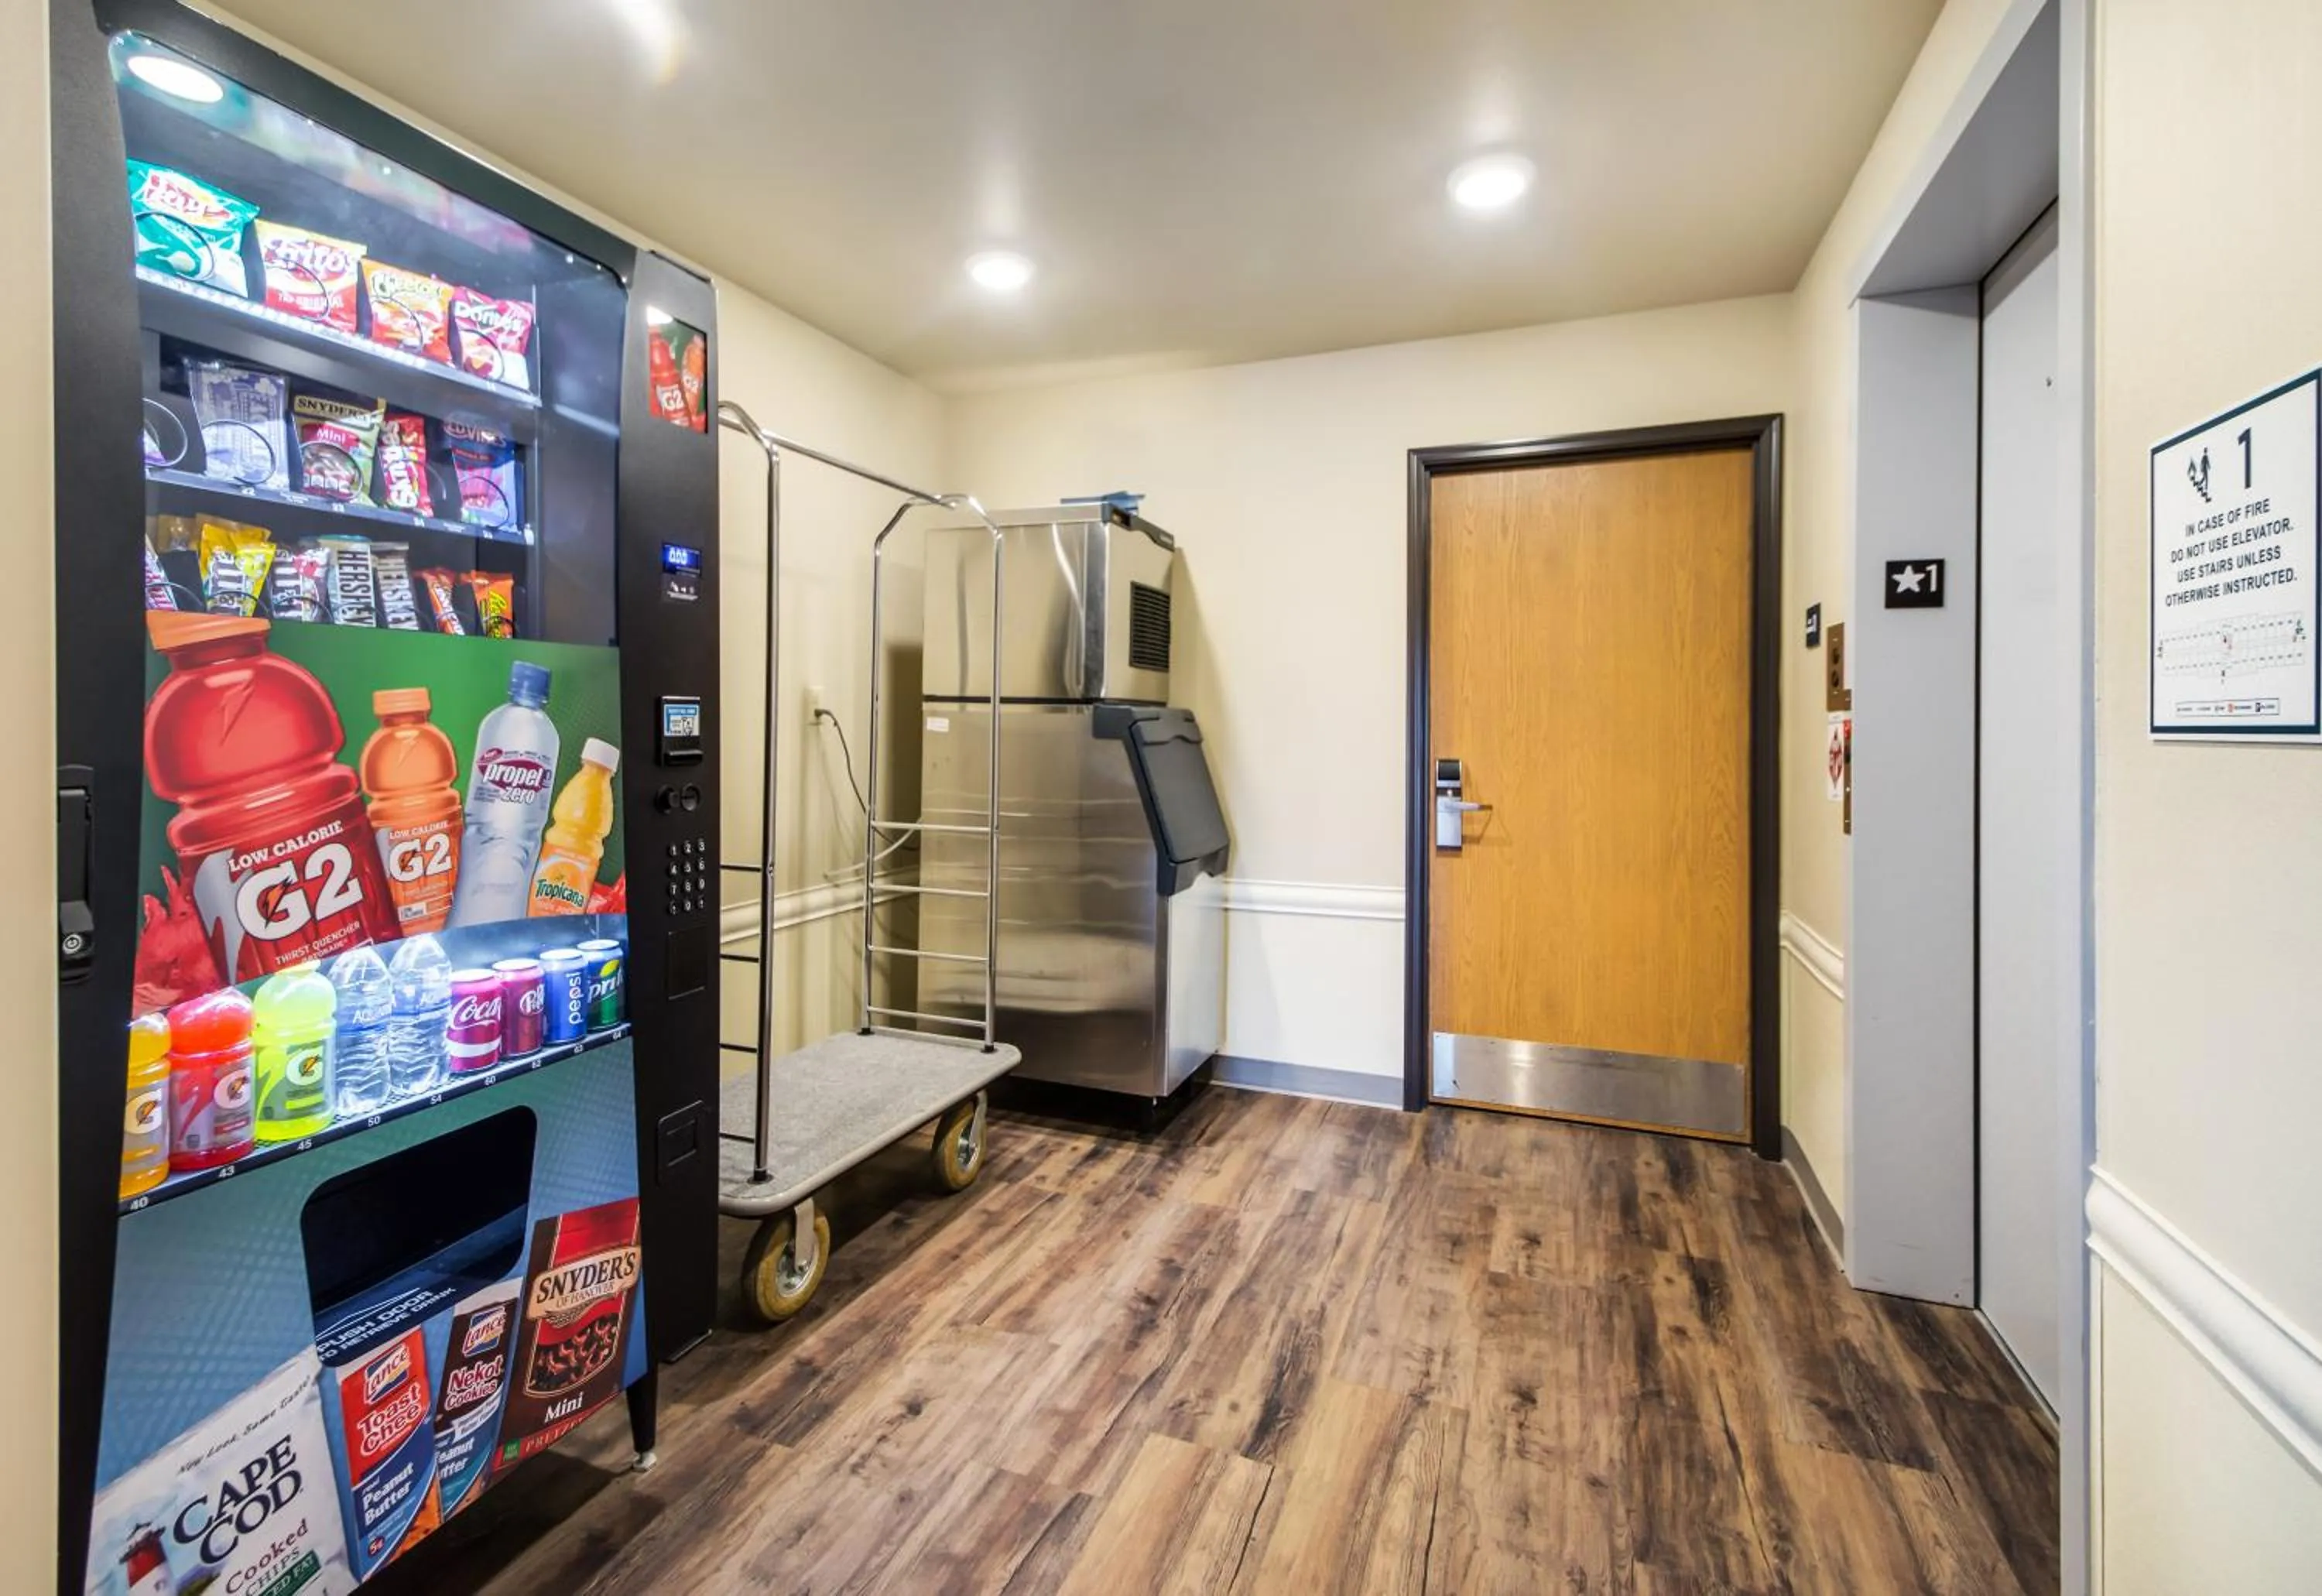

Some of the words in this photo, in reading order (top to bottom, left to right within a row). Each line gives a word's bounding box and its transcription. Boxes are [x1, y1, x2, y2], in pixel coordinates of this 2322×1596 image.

[2236, 426, 2253, 489] 1
[2185, 523, 2195, 537] IN
[2198, 513, 2224, 533] CASE
[2227, 508, 2242, 524] OF
[2245, 498, 2270, 519] FIRE
[2171, 549, 2183, 563] DO
[2187, 543, 2205, 559] NOT
[2208, 535, 2228, 553] USE
[2231, 518, 2293, 547] ELEVATOR.
[1926, 564, 1937, 592] 1
[2177, 567, 2195, 583] USE
[2198, 557, 2233, 577] STAIRS
[2237, 545, 2281, 569] UNLESS
[2165, 583, 2220, 607] OTHERWISE
[2223, 567, 2297, 595] INSTRUCTED.
[483, 762, 543, 786] propel
[501, 786, 535, 805] zero
[228, 848, 269, 872] LOW
[272, 820, 343, 857] CALORIE
[389, 830, 409, 840] LOW
[411, 820, 449, 836] CALORIE
[389, 833, 452, 882] G2
[236, 843, 365, 941] G2
[535, 878, 585, 908] Tropicana
[276, 945, 310, 965] THIRST
[312, 920, 361, 950] QUENCHER
[566, 971, 584, 1025] pepsi
[214, 1066, 252, 1109] G
[286, 1050, 323, 1086] G
[124, 1087, 163, 1134] G
[368, 1115, 381, 1127] 50
[430, 1094, 442, 1105] 54
[297, 1139, 313, 1152] 45
[219, 1165, 235, 1179] 43
[130, 1196, 149, 1211] 40
[536, 1252, 635, 1303] SNYDER'S
[317, 1320, 376, 1353] PUSH
[378, 1290, 434, 1322] DOOR
[339, 1312, 412, 1351] RETRIEVE
[411, 1286, 457, 1313] DRINK
[462, 1313, 505, 1356] Lance
[364, 1344, 411, 1405] Lance
[444, 1379, 498, 1411] Cookies
[448, 1355, 504, 1394] Nekot
[357, 1382, 421, 1434] Toast
[544, 1392, 584, 1423] Mini
[361, 1403, 421, 1457] Chee
[173, 1434, 296, 1544] CAPE
[363, 1461, 414, 1510] Peanut
[365, 1481, 412, 1526] Butter
[200, 1470, 302, 1564] COD
[225, 1517, 309, 1594] Cooked
